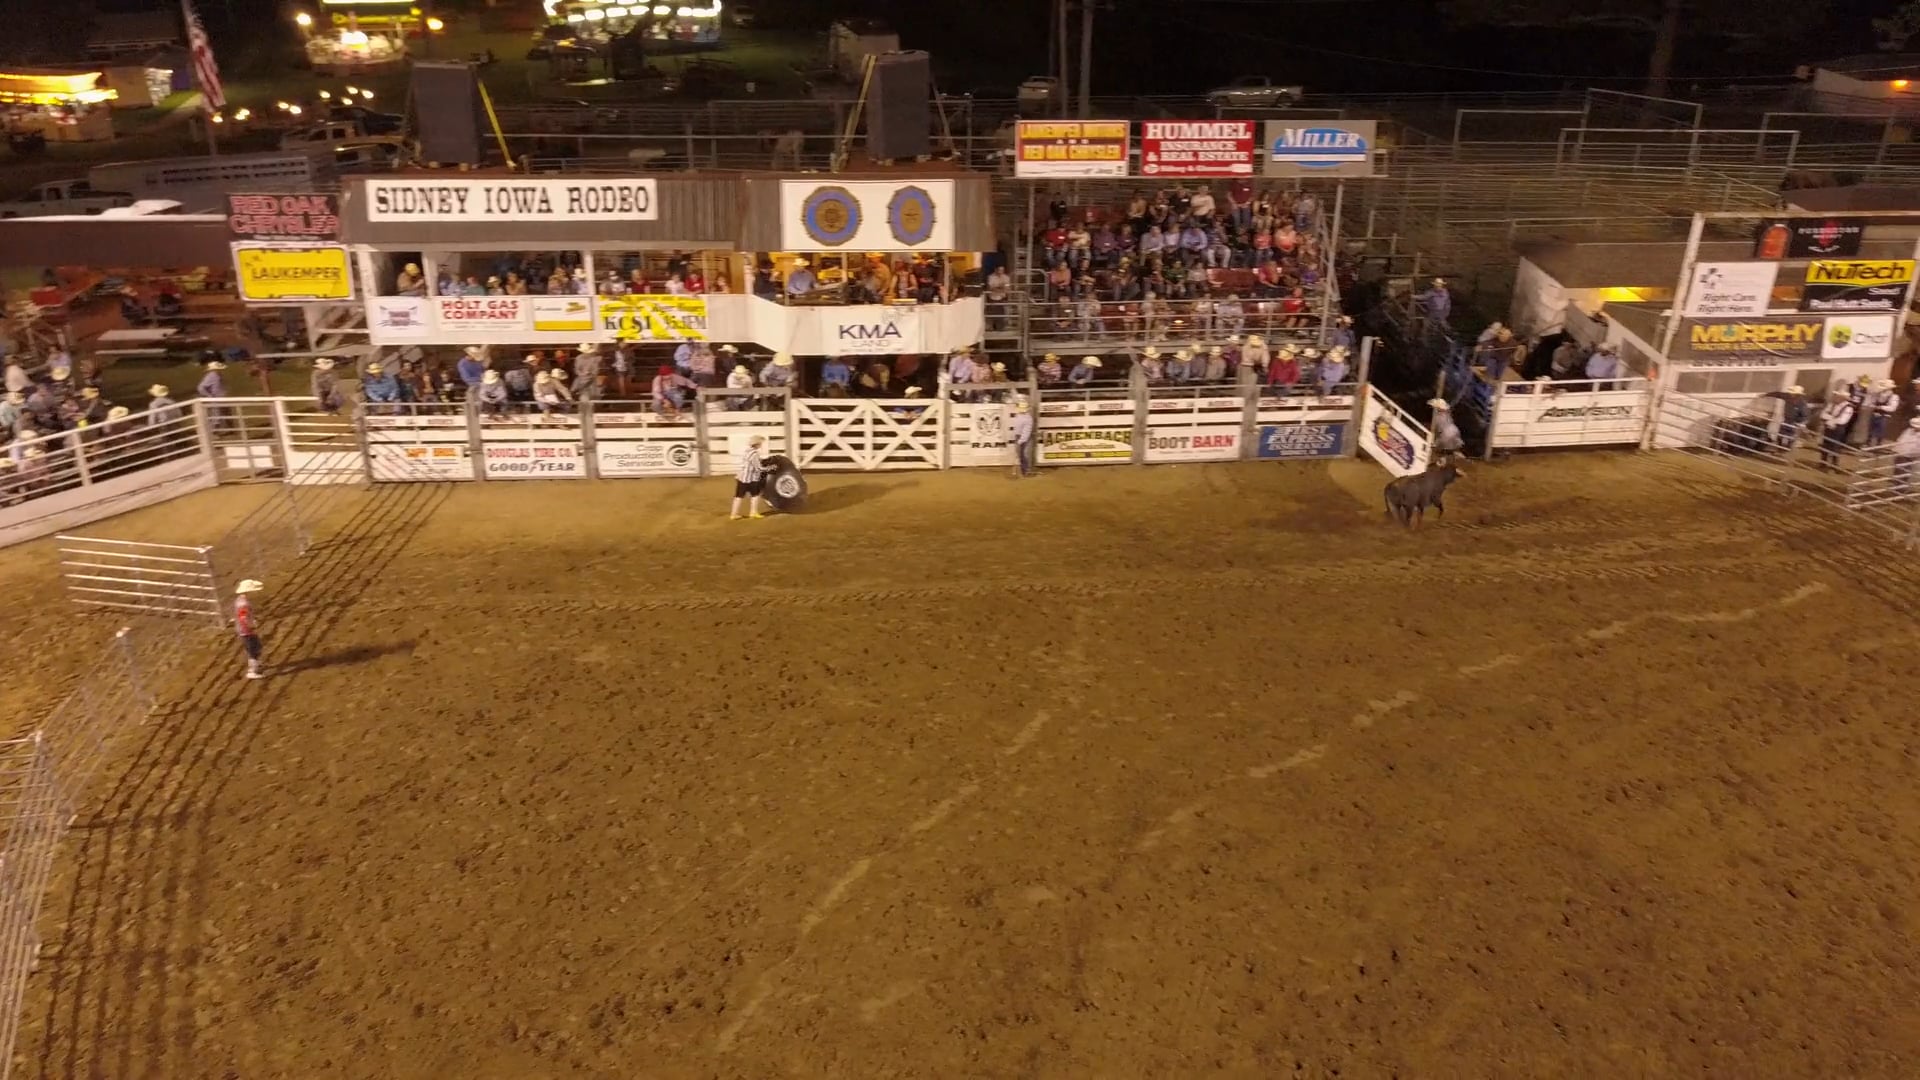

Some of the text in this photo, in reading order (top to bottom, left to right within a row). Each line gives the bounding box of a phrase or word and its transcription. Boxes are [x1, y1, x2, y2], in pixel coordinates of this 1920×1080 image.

[1146, 122, 1252, 139] HUMMEL
[1280, 128, 1360, 147] MILLER
[1160, 141, 1237, 151] INSURANCE
[1197, 152, 1249, 161] ESTATE
[230, 195, 330, 214] RED OAK
[375, 186, 650, 214] SIDNEY IOWA RODEO
[230, 215, 340, 233] CHRYSLER
[251, 266, 341, 279] LAUKEMPER
[1816, 262, 1905, 279] NuTech
[441, 300, 519, 310] HOLT GAS
[442, 310, 518, 320] COMPANY
[838, 321, 903, 339] KMA
[1691, 323, 1822, 342] MURPHY
[971, 441, 1008, 449] RAM
[1148, 434, 1235, 450] BOOT BARN
[602, 452, 664, 461] Production
[616, 459, 664, 468] Services
